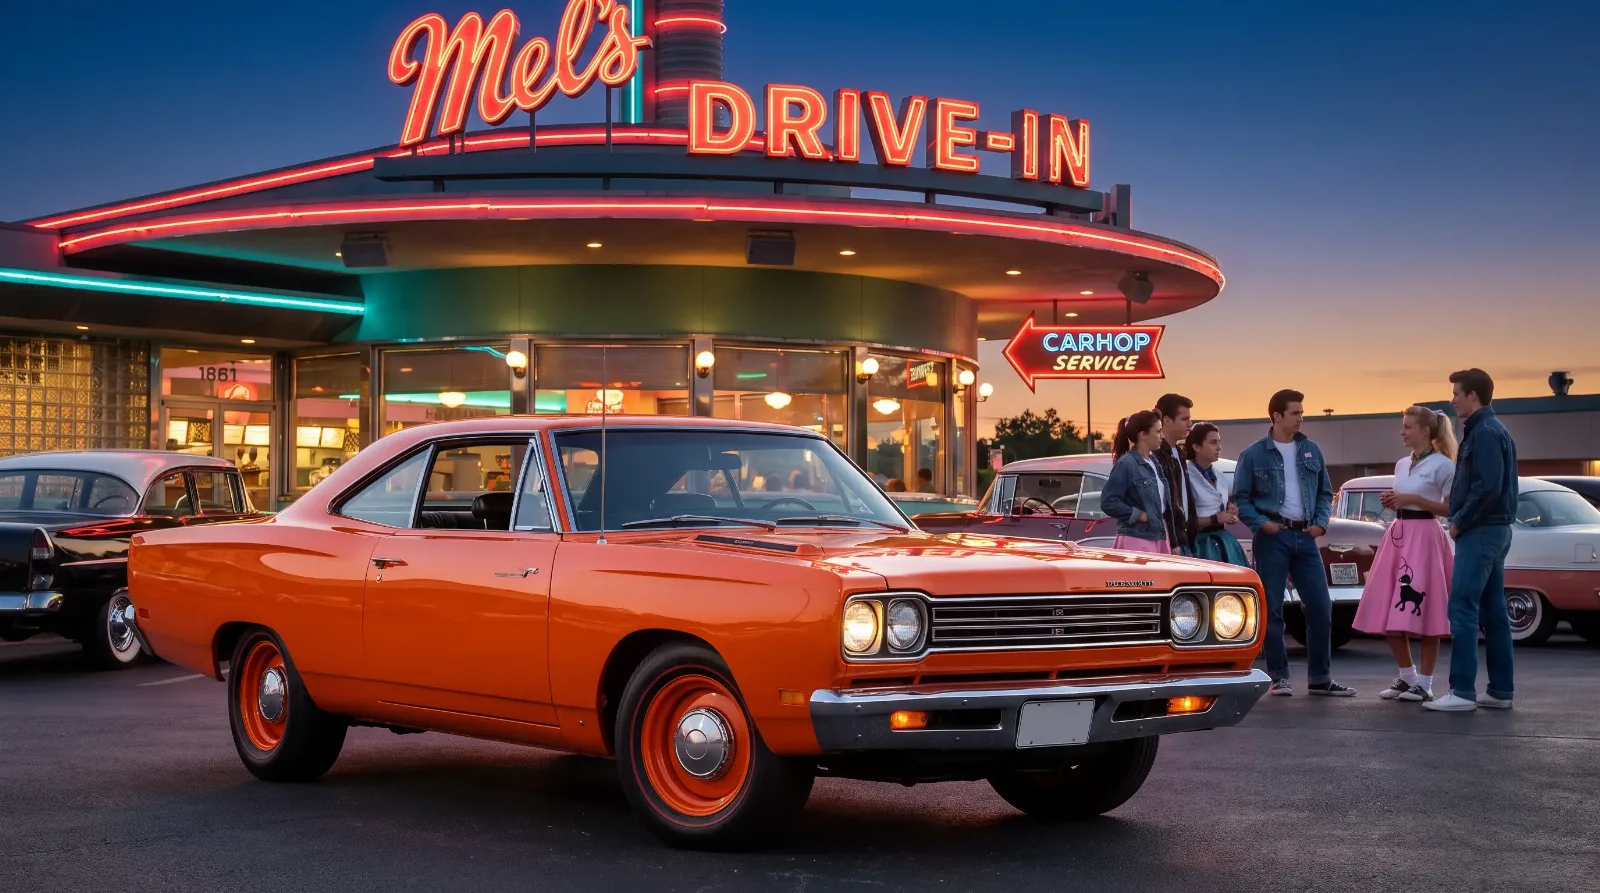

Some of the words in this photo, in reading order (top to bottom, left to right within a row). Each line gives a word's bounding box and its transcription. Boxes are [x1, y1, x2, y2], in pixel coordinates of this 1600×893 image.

[388, 0, 653, 148] Mel's
[687, 79, 1091, 188] DRIVE-IN
[1042, 332, 1151, 352] CARHOP
[1052, 355, 1140, 371] SERVICE
